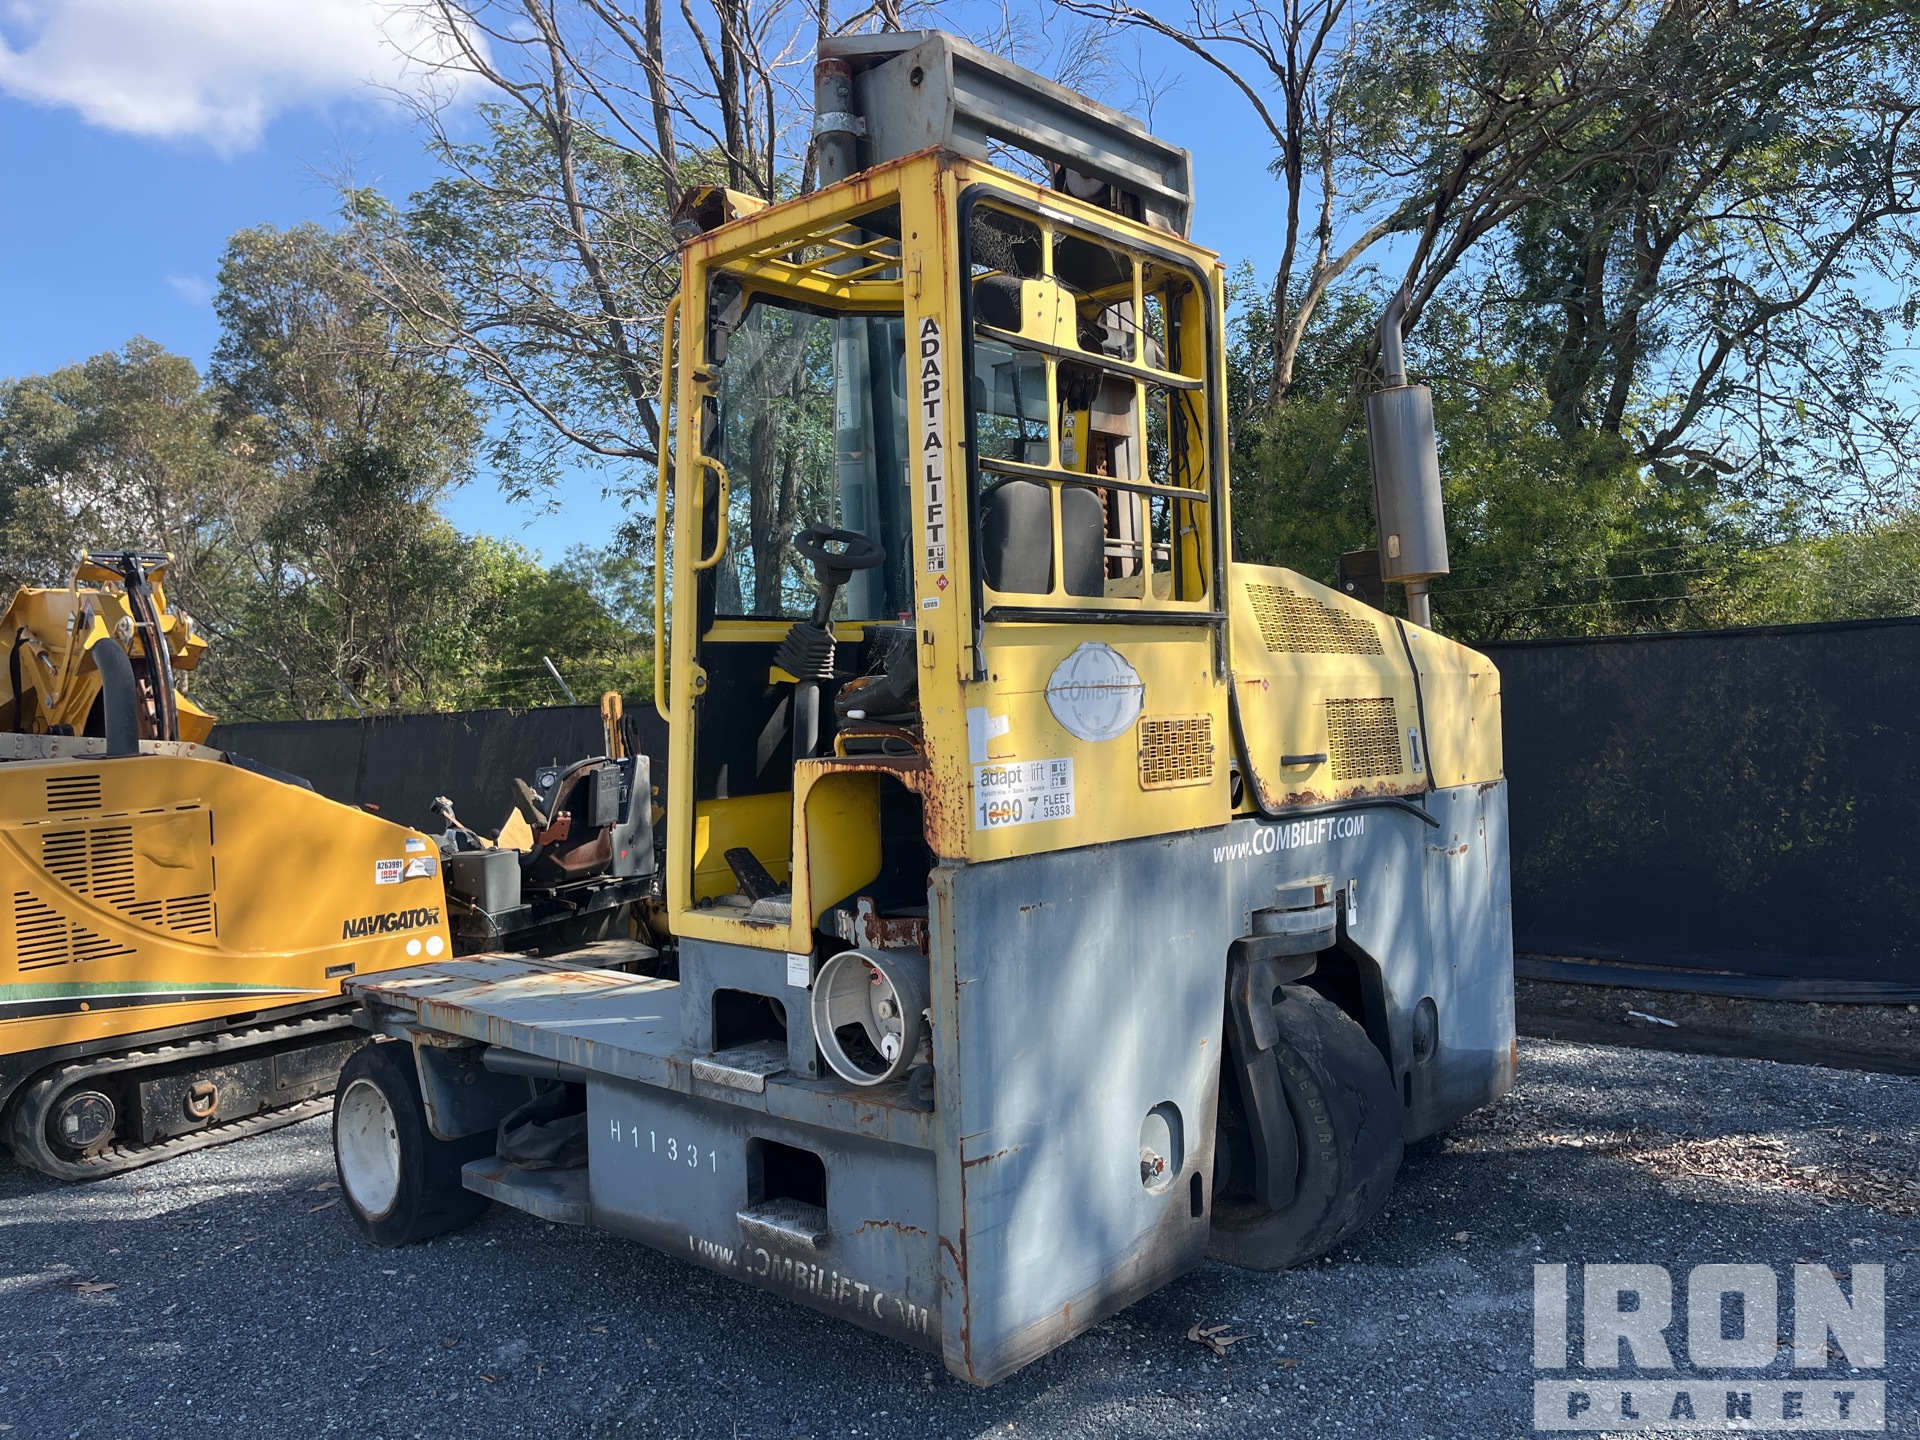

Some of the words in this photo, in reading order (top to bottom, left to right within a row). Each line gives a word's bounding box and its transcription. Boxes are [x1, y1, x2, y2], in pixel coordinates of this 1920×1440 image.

[1043, 792, 1070, 806] FLEET
[1043, 804, 1070, 817] 35338
[377, 860, 403, 869] A263991
[342, 907, 439, 939] NAVIGATOR
